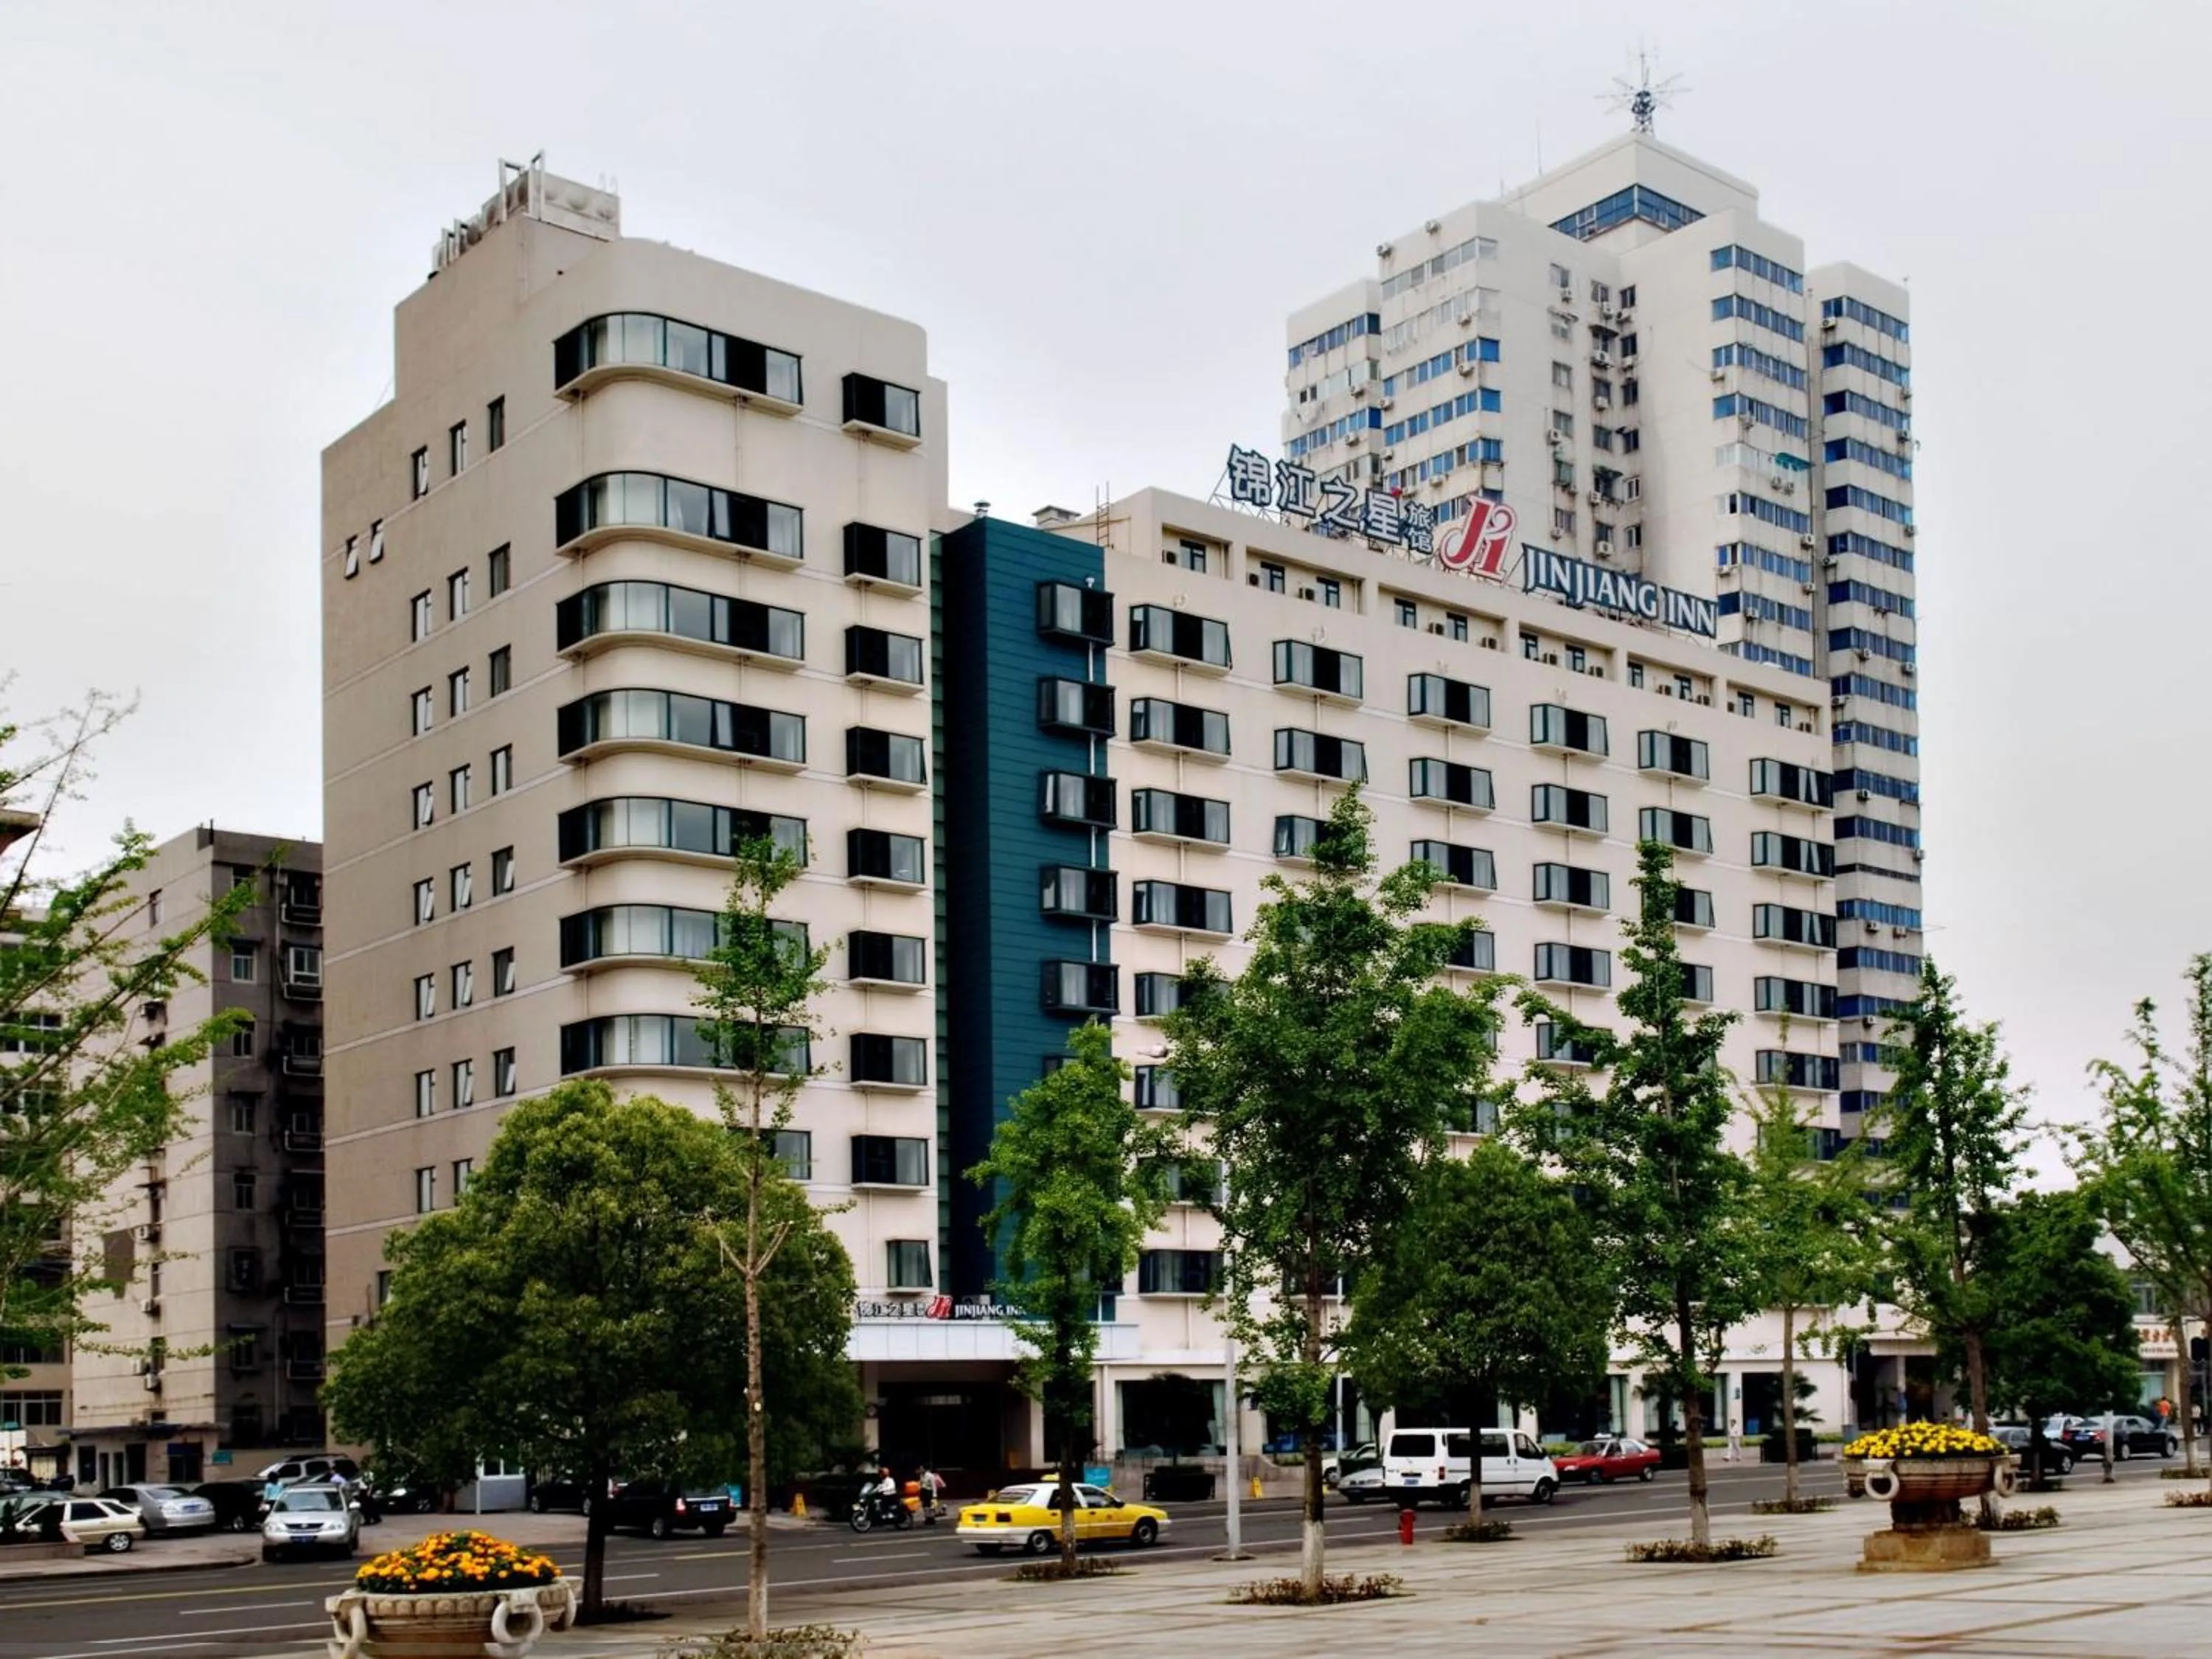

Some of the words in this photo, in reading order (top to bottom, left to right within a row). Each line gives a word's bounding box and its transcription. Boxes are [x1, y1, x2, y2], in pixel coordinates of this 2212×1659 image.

[1228, 443, 1402, 546] 锦江之星
[1521, 543, 1658, 619] JINJIANG
[1660, 585, 1717, 639] INN
[955, 1304, 1004, 1318] JINJIANG
